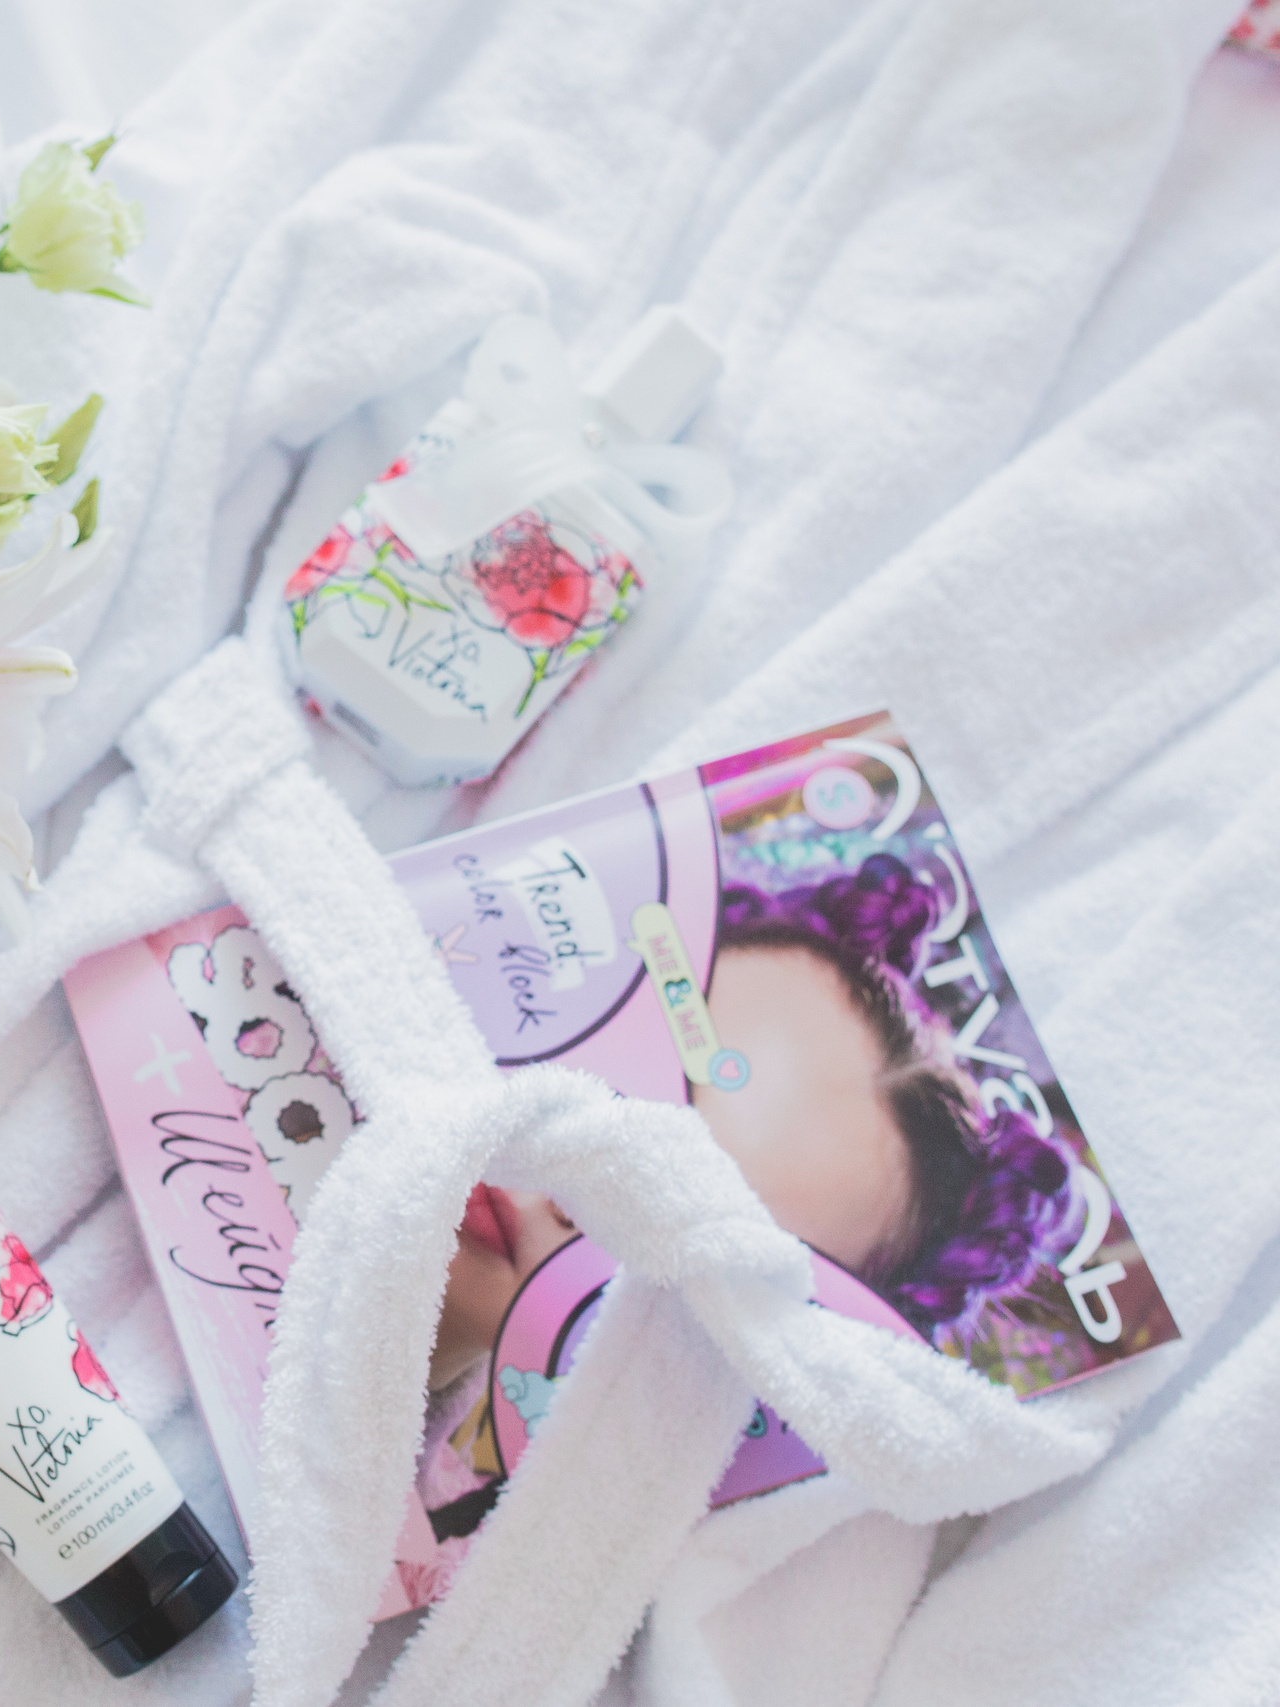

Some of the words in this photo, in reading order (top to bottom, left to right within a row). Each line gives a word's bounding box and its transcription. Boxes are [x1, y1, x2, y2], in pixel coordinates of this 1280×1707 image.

[649, 935, 678, 975] ME
[664, 977, 692, 1008] &
[676, 1010, 706, 1052] ME
[34, 1476, 94, 1526] FRAGRANCE
[95, 1449, 131, 1479] LOTION
[46, 1504, 84, 1536] LOTION
